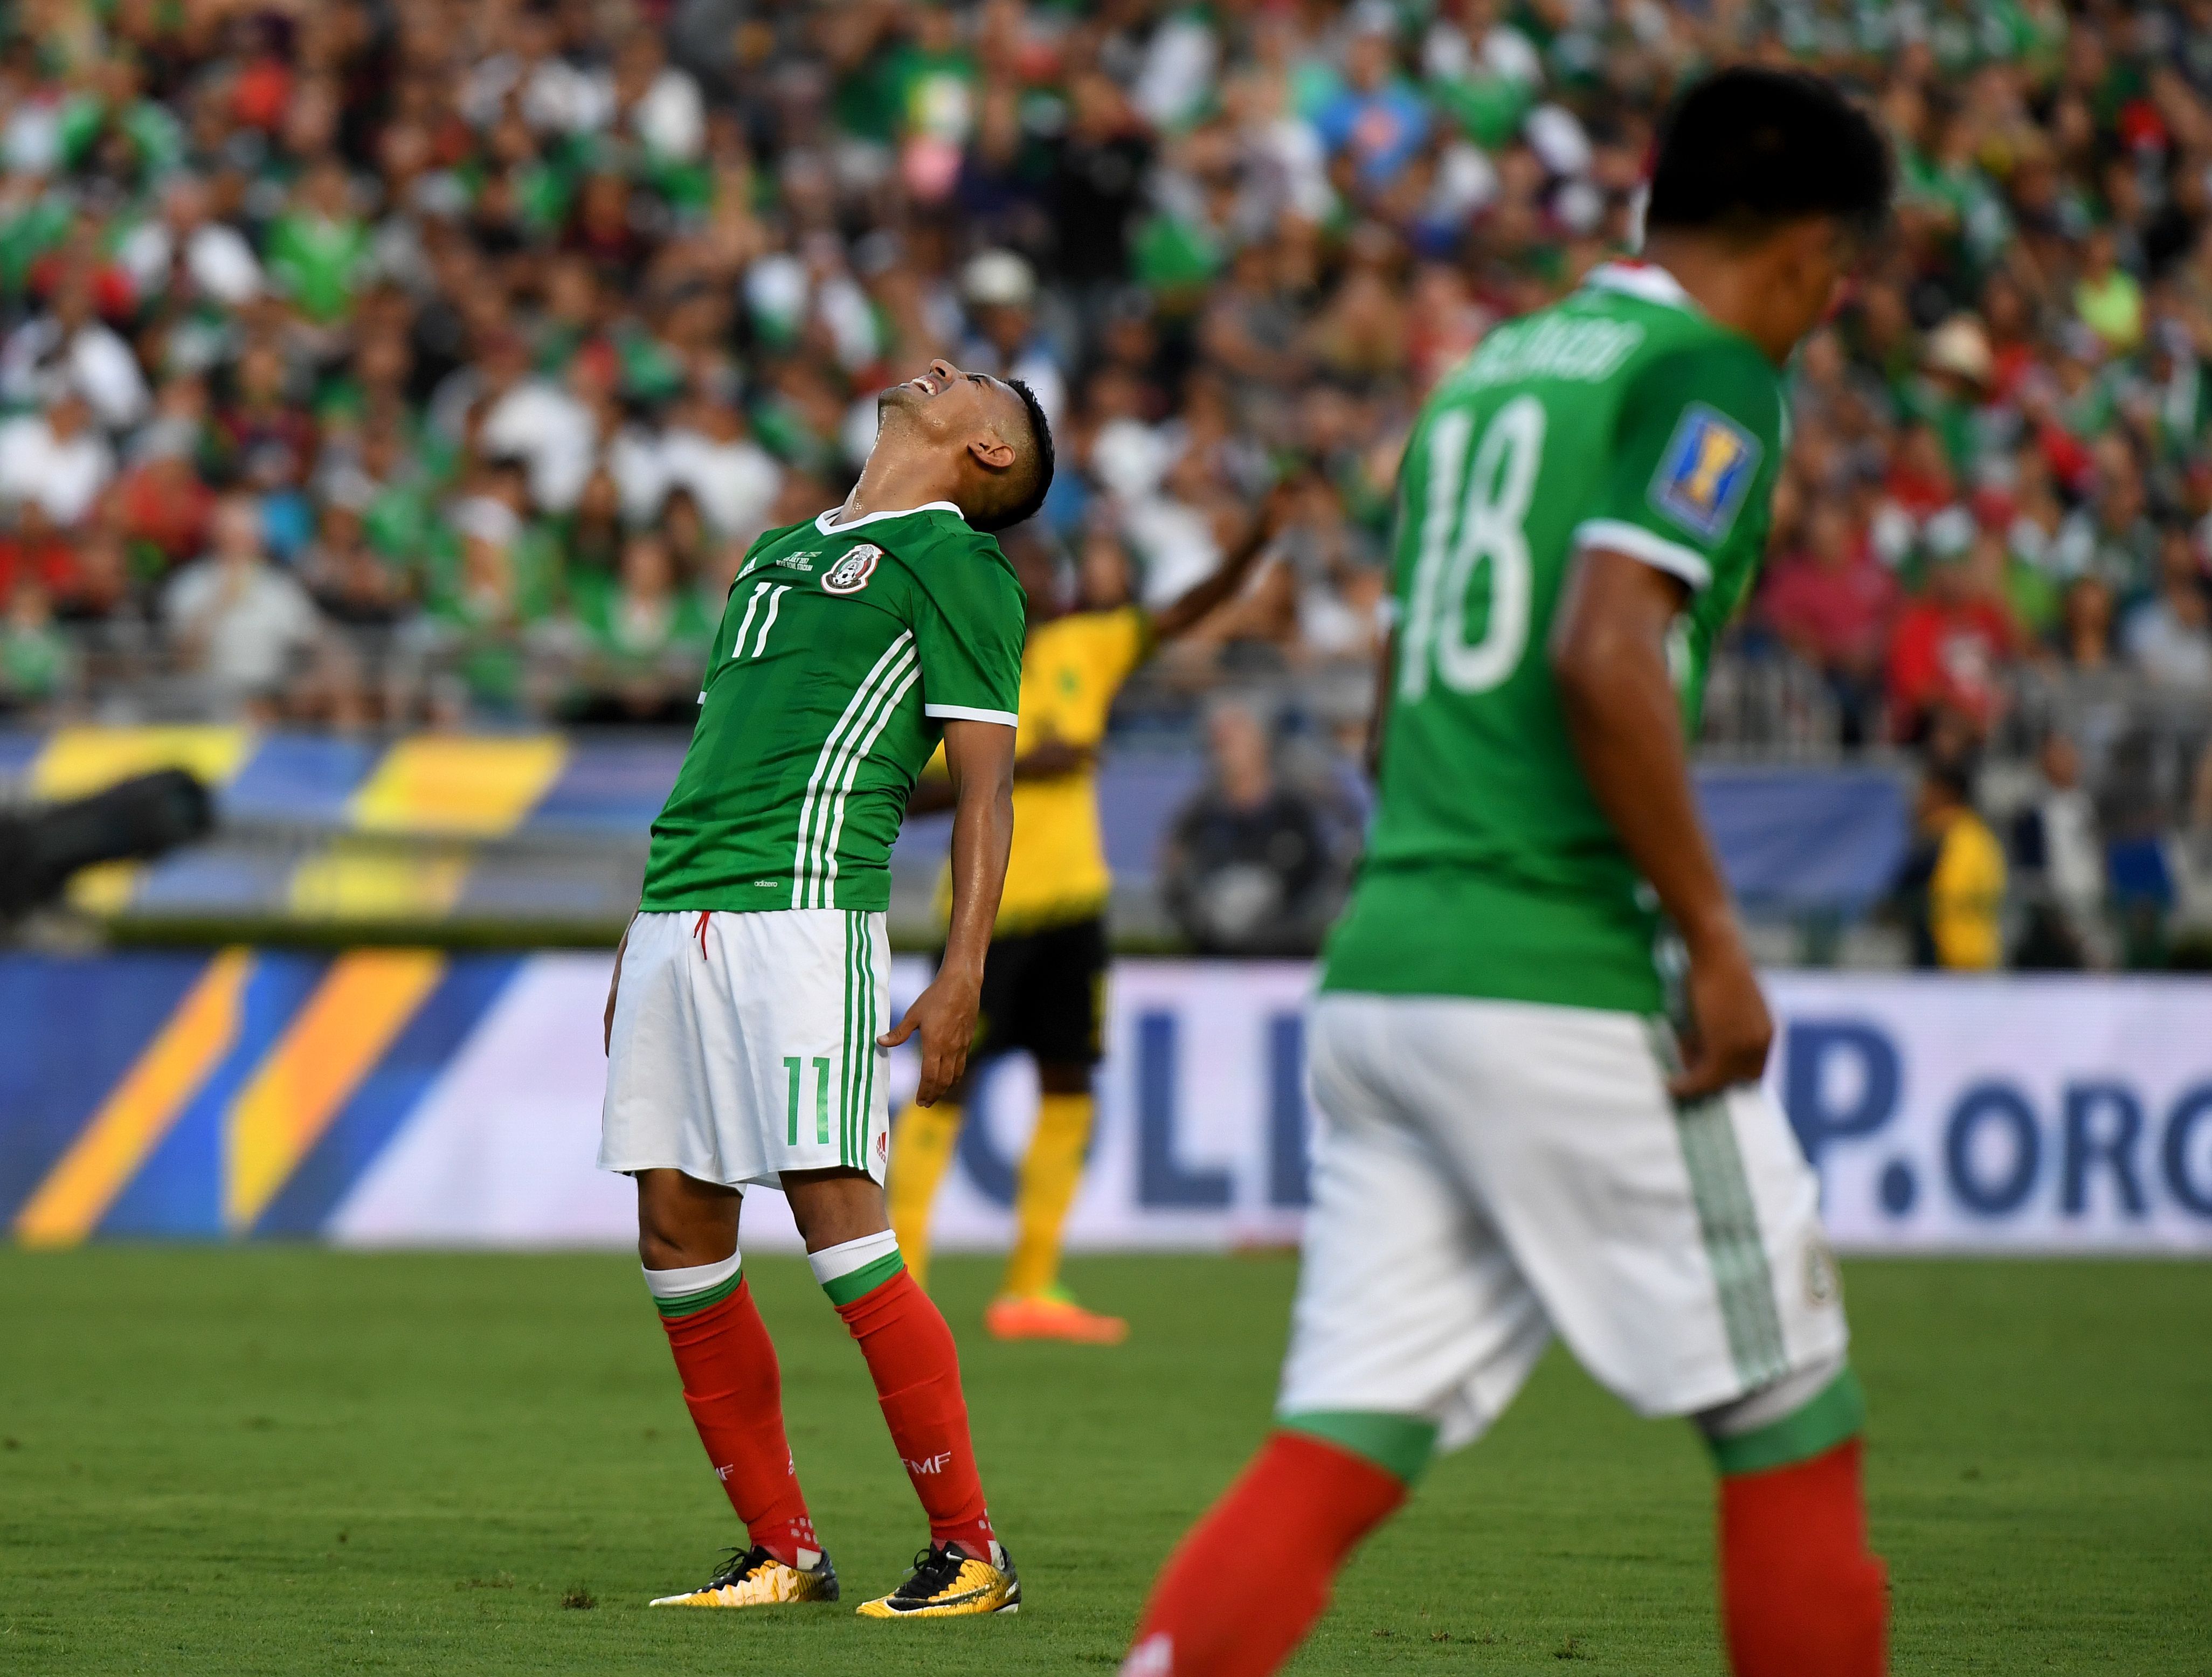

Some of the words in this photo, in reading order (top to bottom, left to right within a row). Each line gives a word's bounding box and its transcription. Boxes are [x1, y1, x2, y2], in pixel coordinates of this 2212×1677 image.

[1397, 394, 1547, 707] 18
[731, 582, 793, 658] 11
[783, 1056, 831, 1146] 11
